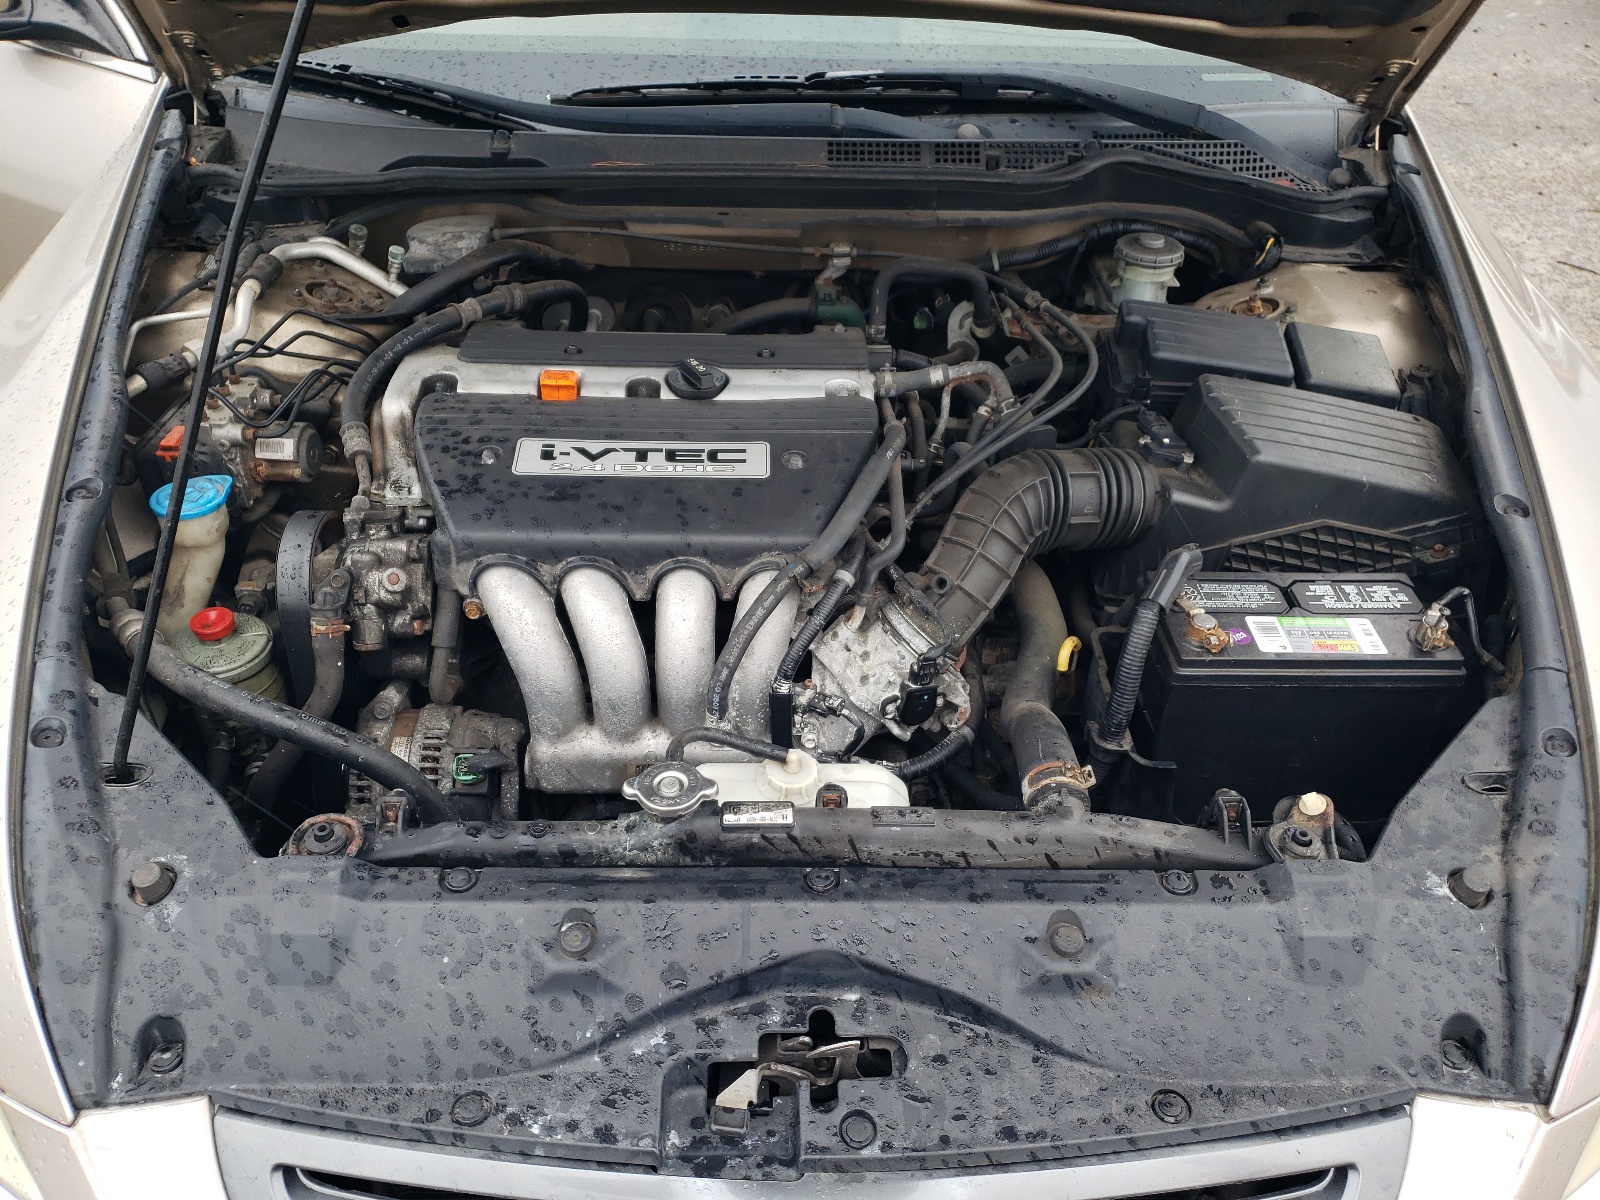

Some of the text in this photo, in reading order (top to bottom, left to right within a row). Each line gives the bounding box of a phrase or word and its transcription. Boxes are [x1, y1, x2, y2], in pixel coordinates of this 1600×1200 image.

[540, 443, 747, 463] i-VTEC
[550, 463, 735, 473] 2.4 DOHC
